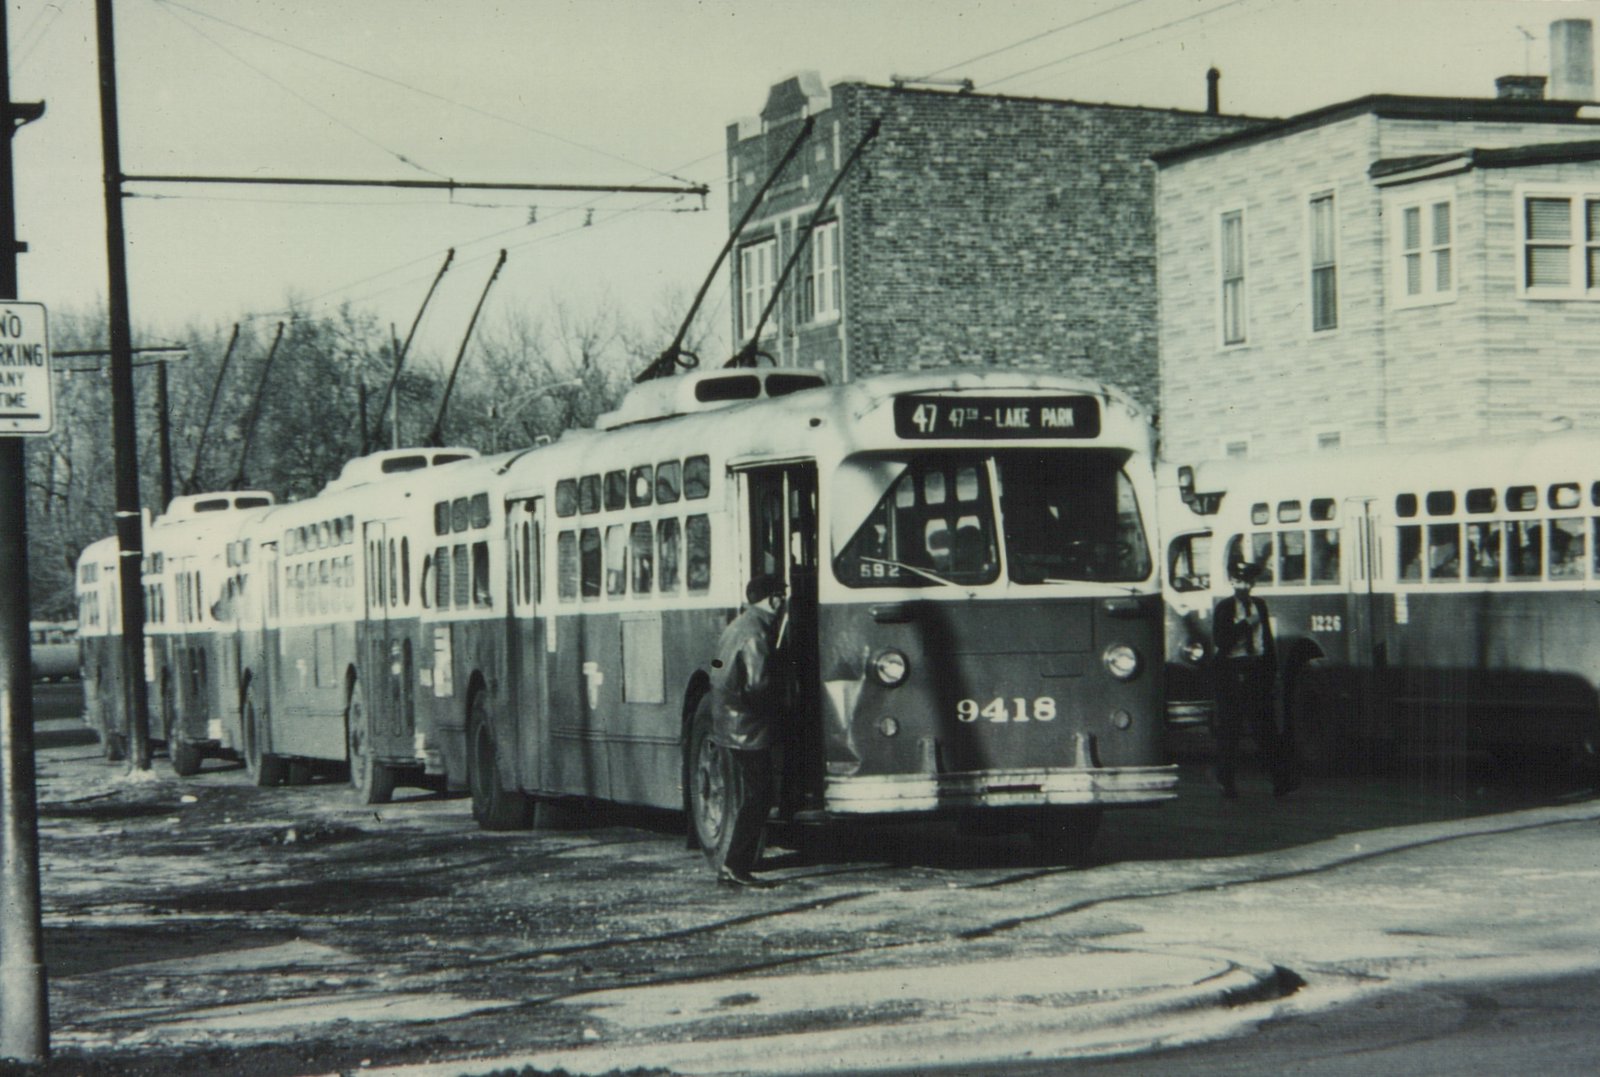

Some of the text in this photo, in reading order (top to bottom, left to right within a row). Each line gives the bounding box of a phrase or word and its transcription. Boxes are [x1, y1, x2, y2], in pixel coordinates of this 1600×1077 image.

[0, 343, 44, 367] RKING
[912, 404, 938, 433] 47
[995, 407, 1031, 428] LAKE
[1040, 407, 1074, 428] PARK
[956, 696, 1057, 723] 9418
